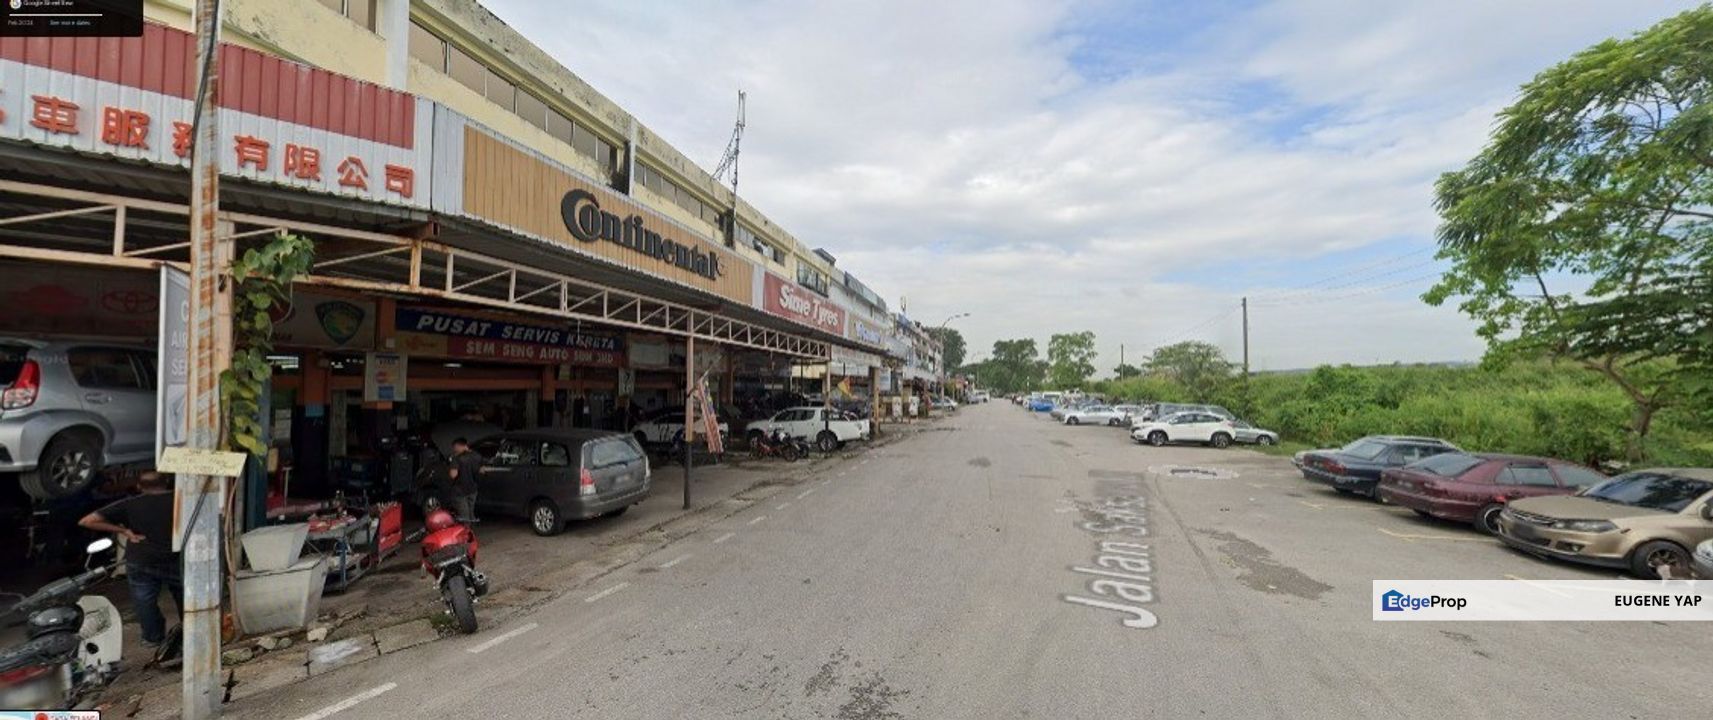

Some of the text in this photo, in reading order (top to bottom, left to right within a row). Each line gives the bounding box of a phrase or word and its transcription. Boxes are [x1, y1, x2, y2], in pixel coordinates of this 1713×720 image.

[561, 188, 717, 281] Continental
[780, 284, 839, 326] Sime Tyres
[416, 314, 615, 350] PUSAT SERVIS KERETA
[466, 340, 496, 355] SEM
[503, 343, 534, 359] SENG
[539, 347, 569, 361] AUTO
